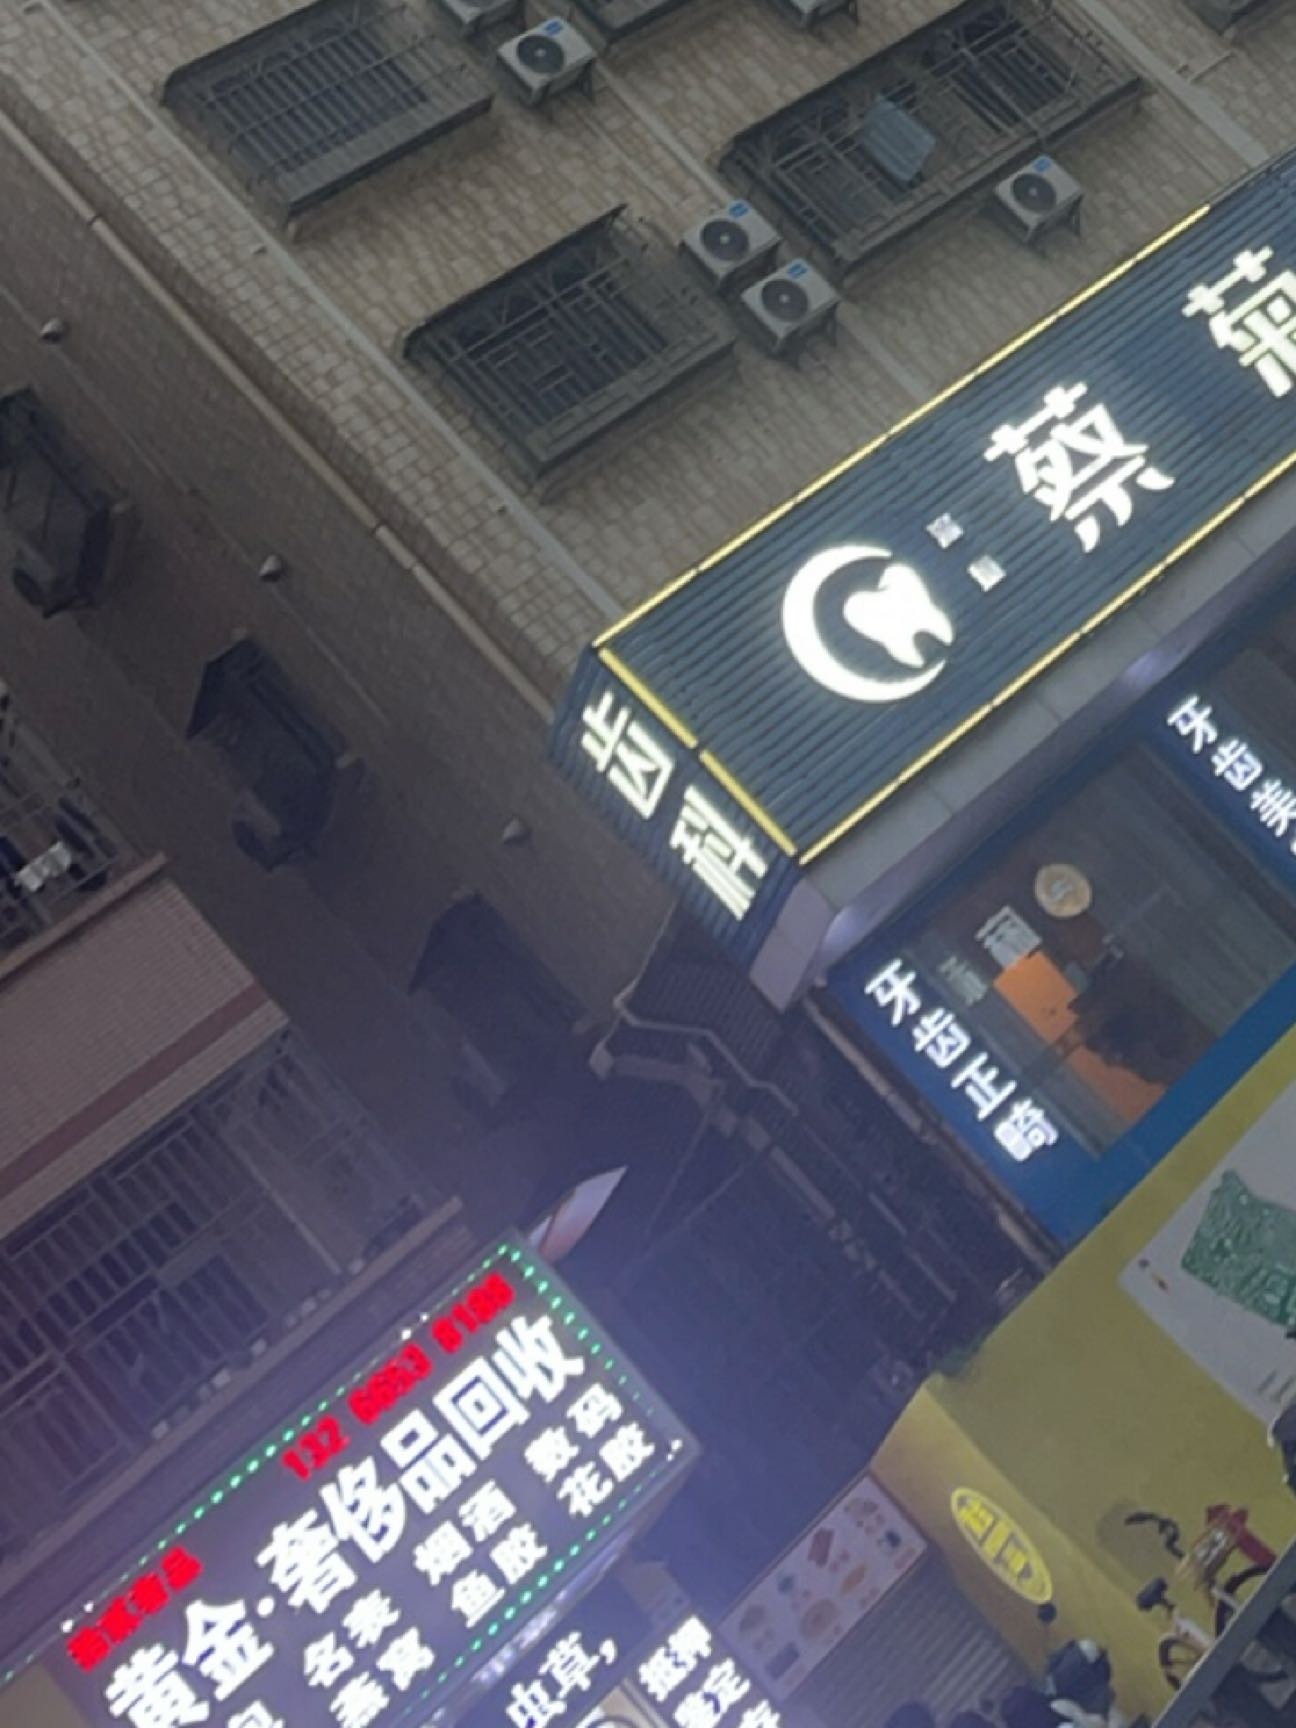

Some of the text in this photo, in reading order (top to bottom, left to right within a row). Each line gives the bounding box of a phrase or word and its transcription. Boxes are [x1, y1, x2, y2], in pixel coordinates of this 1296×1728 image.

[581, 691, 767, 921] 齿科
[864, 958, 1059, 1162] 牙齿正畸
[303, 1383, 622, 1688] 名表 烟酒 数码
[450, 1522, 548, 1629] 鱼胶
[557, 1422, 655, 1518] 花胶
[639, 1615, 712, 1702] 抵押
